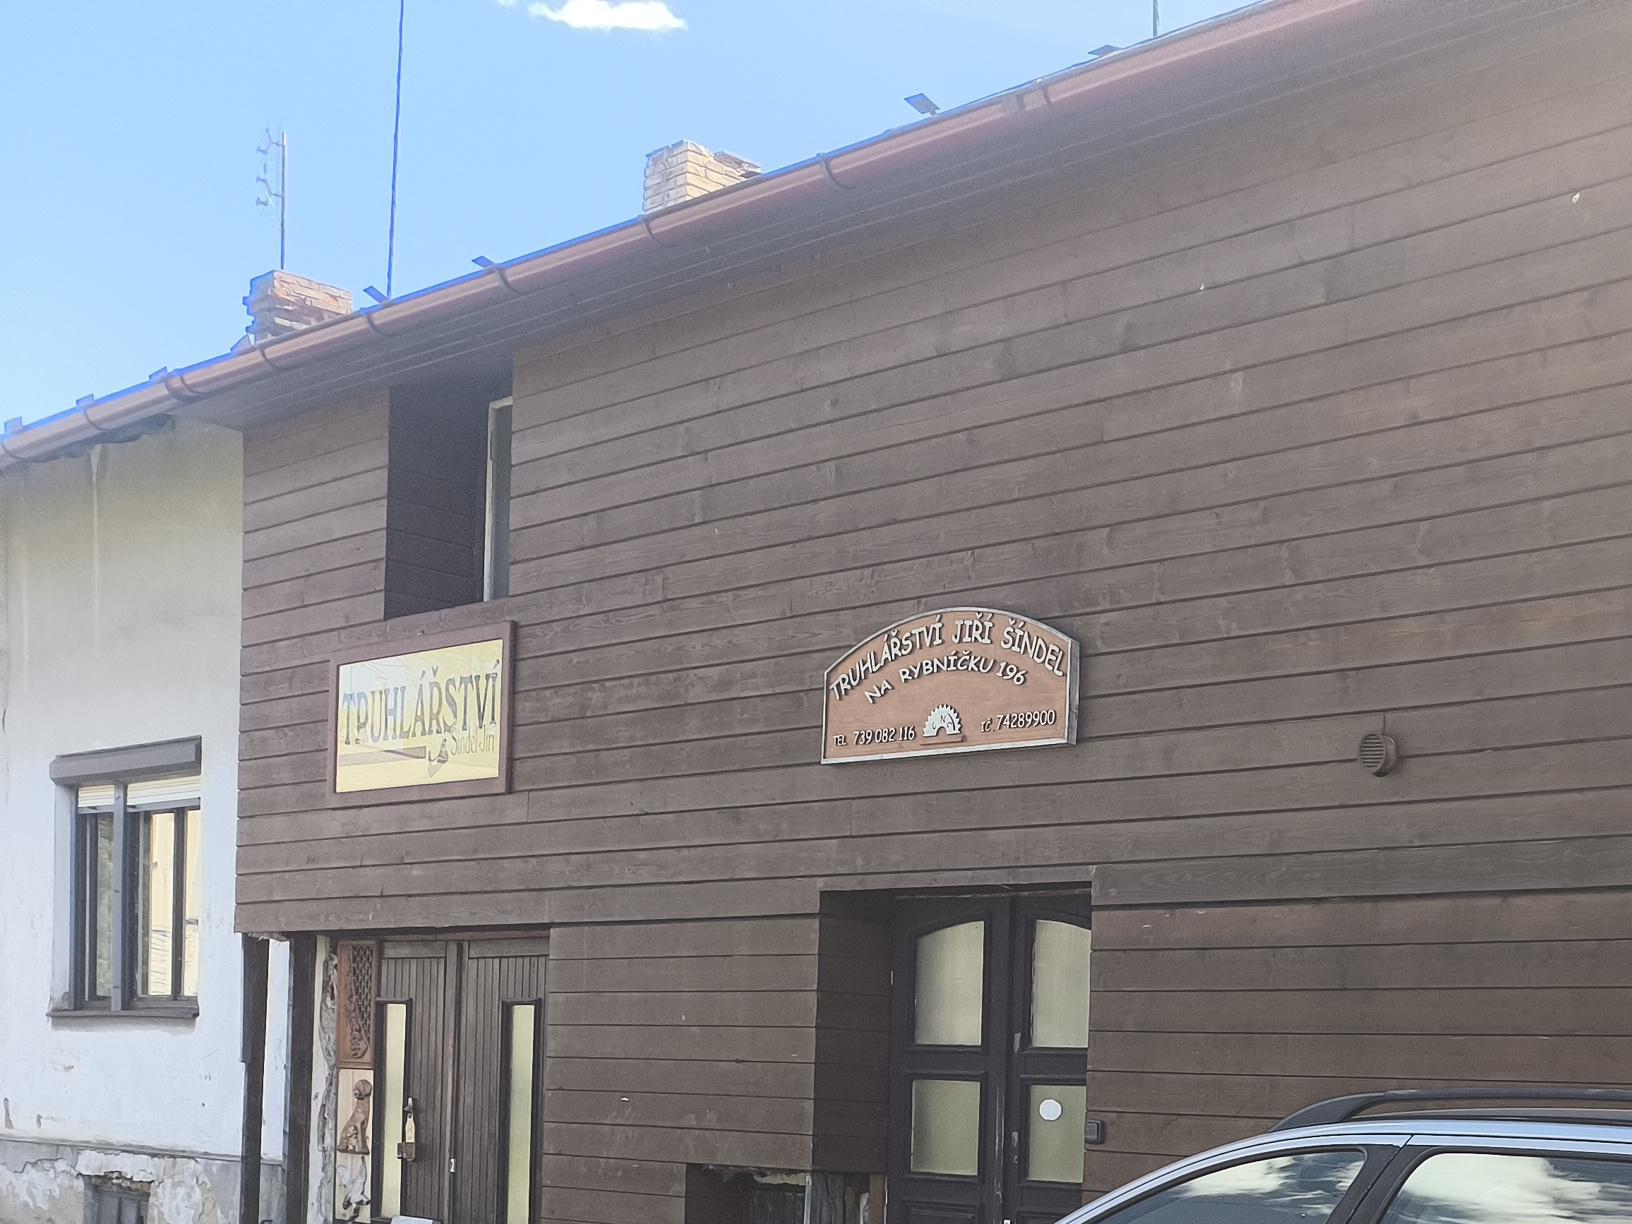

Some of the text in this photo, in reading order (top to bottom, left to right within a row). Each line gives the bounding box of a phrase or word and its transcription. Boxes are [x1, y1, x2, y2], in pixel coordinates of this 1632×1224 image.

[828, 612, 1065, 700] TRUHLÁŘSTVÍ JIŘÍ ŠÍNDEL
[863, 650, 1028, 704] NA RYBNÍČKU 196
[342, 659, 500, 745] TRUHLÁŘSTVÍ
[996, 709, 1056, 731] 74289900
[832, 724, 916, 747] TEL 739 082 116
